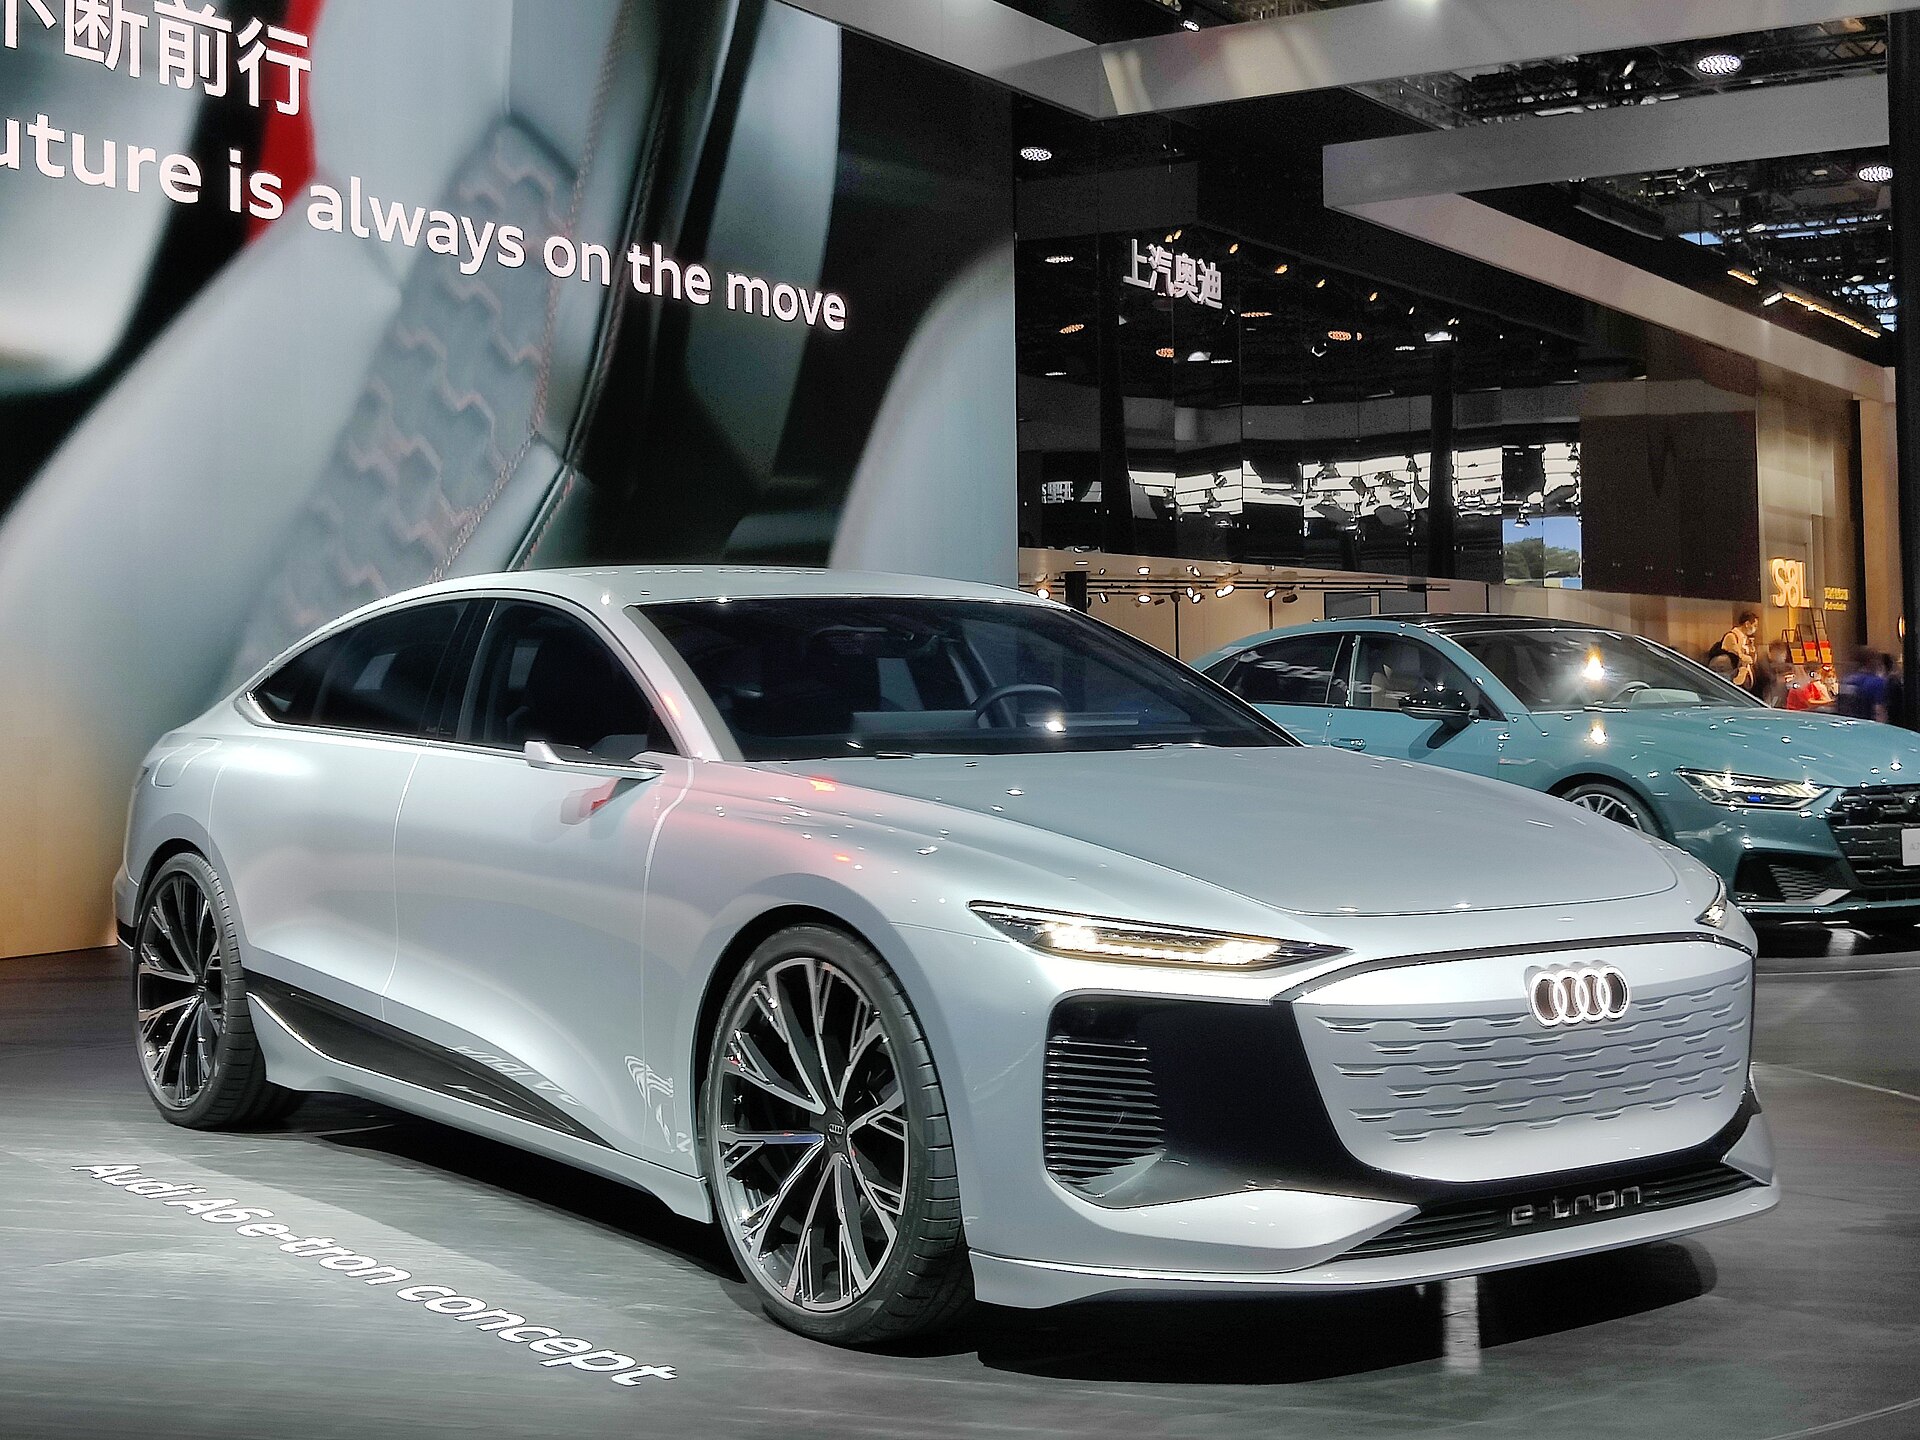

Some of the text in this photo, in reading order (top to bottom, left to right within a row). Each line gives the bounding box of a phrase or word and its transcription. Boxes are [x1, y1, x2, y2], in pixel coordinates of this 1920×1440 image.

[229, 149, 284, 220] is
[306, 175, 525, 276] always
[542, 235, 610, 286] on
[627, 242, 712, 305] the
[726, 271, 847, 332] move
[1123, 238, 1223, 309] 上汽奥迪
[1510, 1185, 1642, 1227] e-tron
[70, 1164, 678, 1387] Audi A6 e-tron concept
